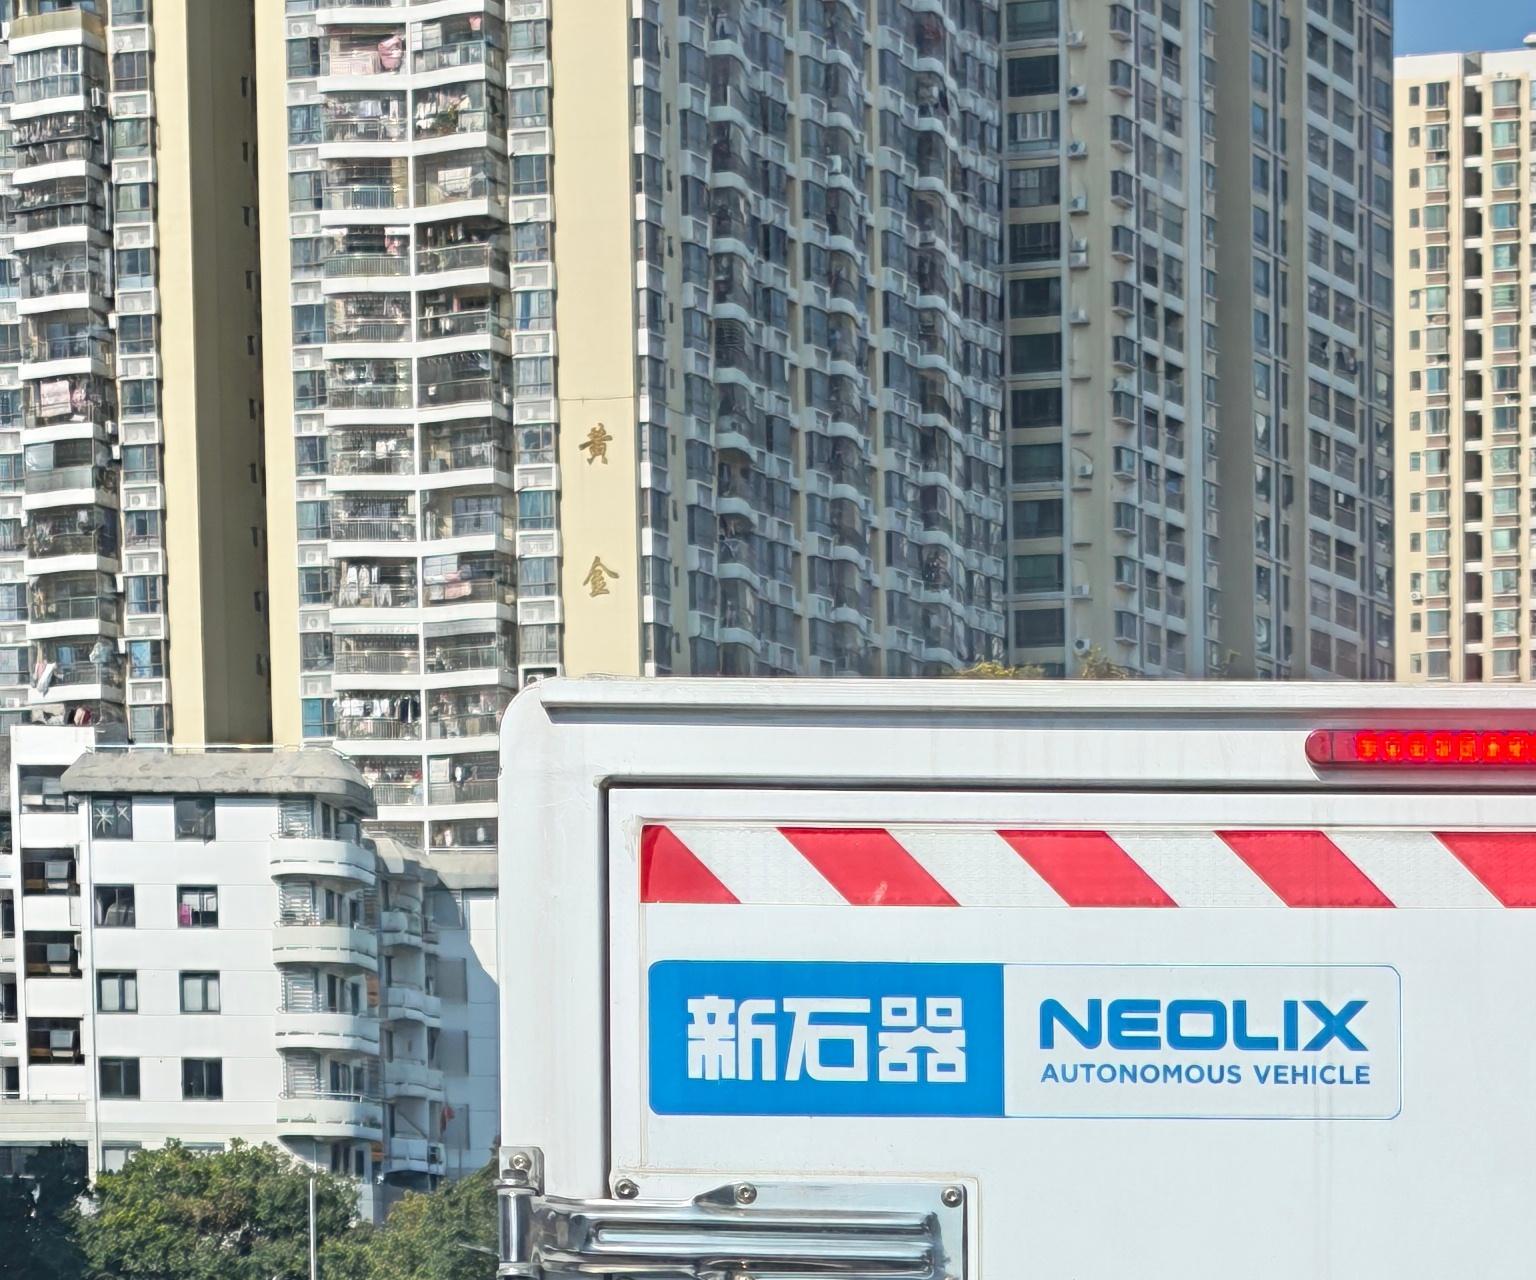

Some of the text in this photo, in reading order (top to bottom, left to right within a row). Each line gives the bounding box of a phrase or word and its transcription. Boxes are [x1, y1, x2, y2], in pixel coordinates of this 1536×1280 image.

[688, 996, 967, 1083] 新石器
[1039, 998, 1369, 1052] NEOLIX
[1041, 1064, 1371, 1085] AUTONOMOUS VEHICLE
